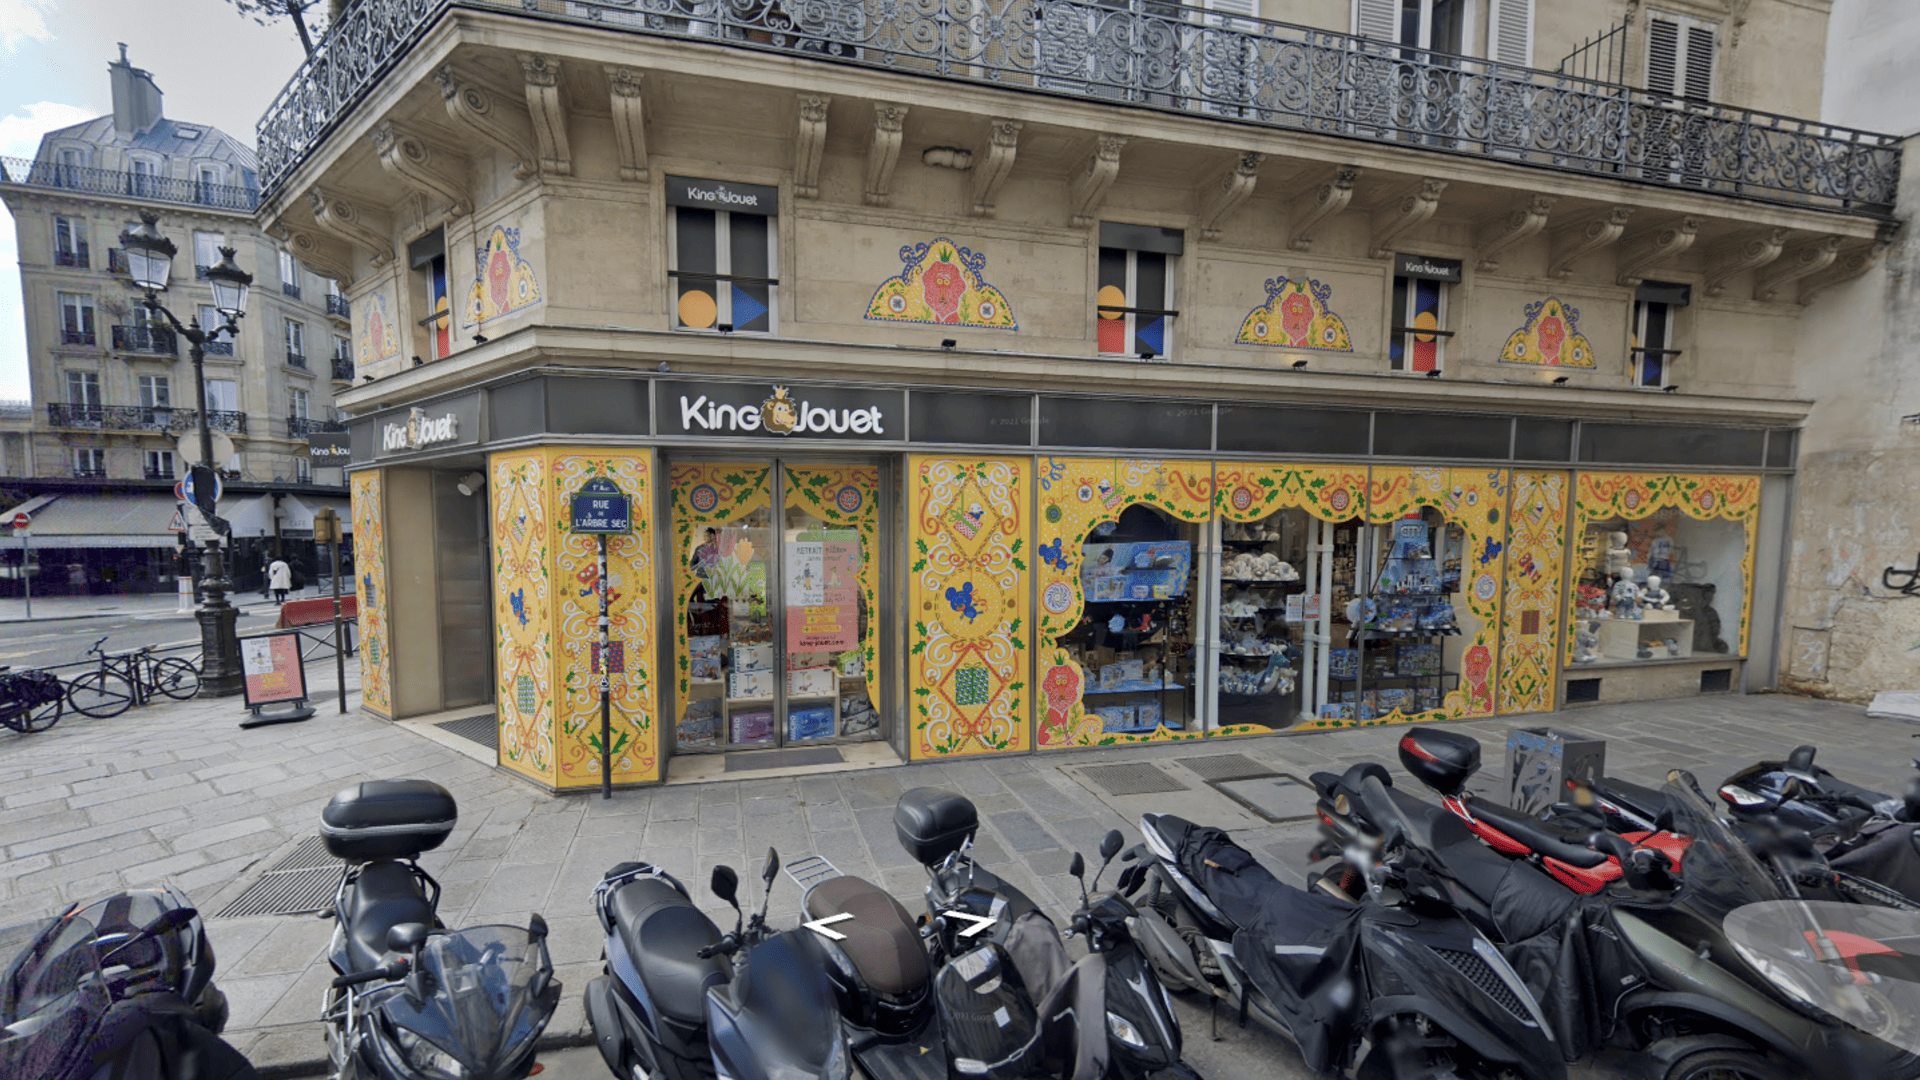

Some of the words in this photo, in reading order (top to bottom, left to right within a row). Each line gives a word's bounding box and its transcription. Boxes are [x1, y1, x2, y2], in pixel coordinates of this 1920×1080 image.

[687, 187, 715, 201] King
[724, 191, 758, 206] Jouet
[680, 395, 761, 431] King
[792, 400, 884, 434] Jouet
[383, 422, 407, 451] King
[418, 413, 454, 444] Jouet
[337, 446, 350, 456] Jou
[592, 499, 609, 509] RUE
[575, 518, 608, 528] L'ARBRE
[611, 518, 627, 528] SEC
